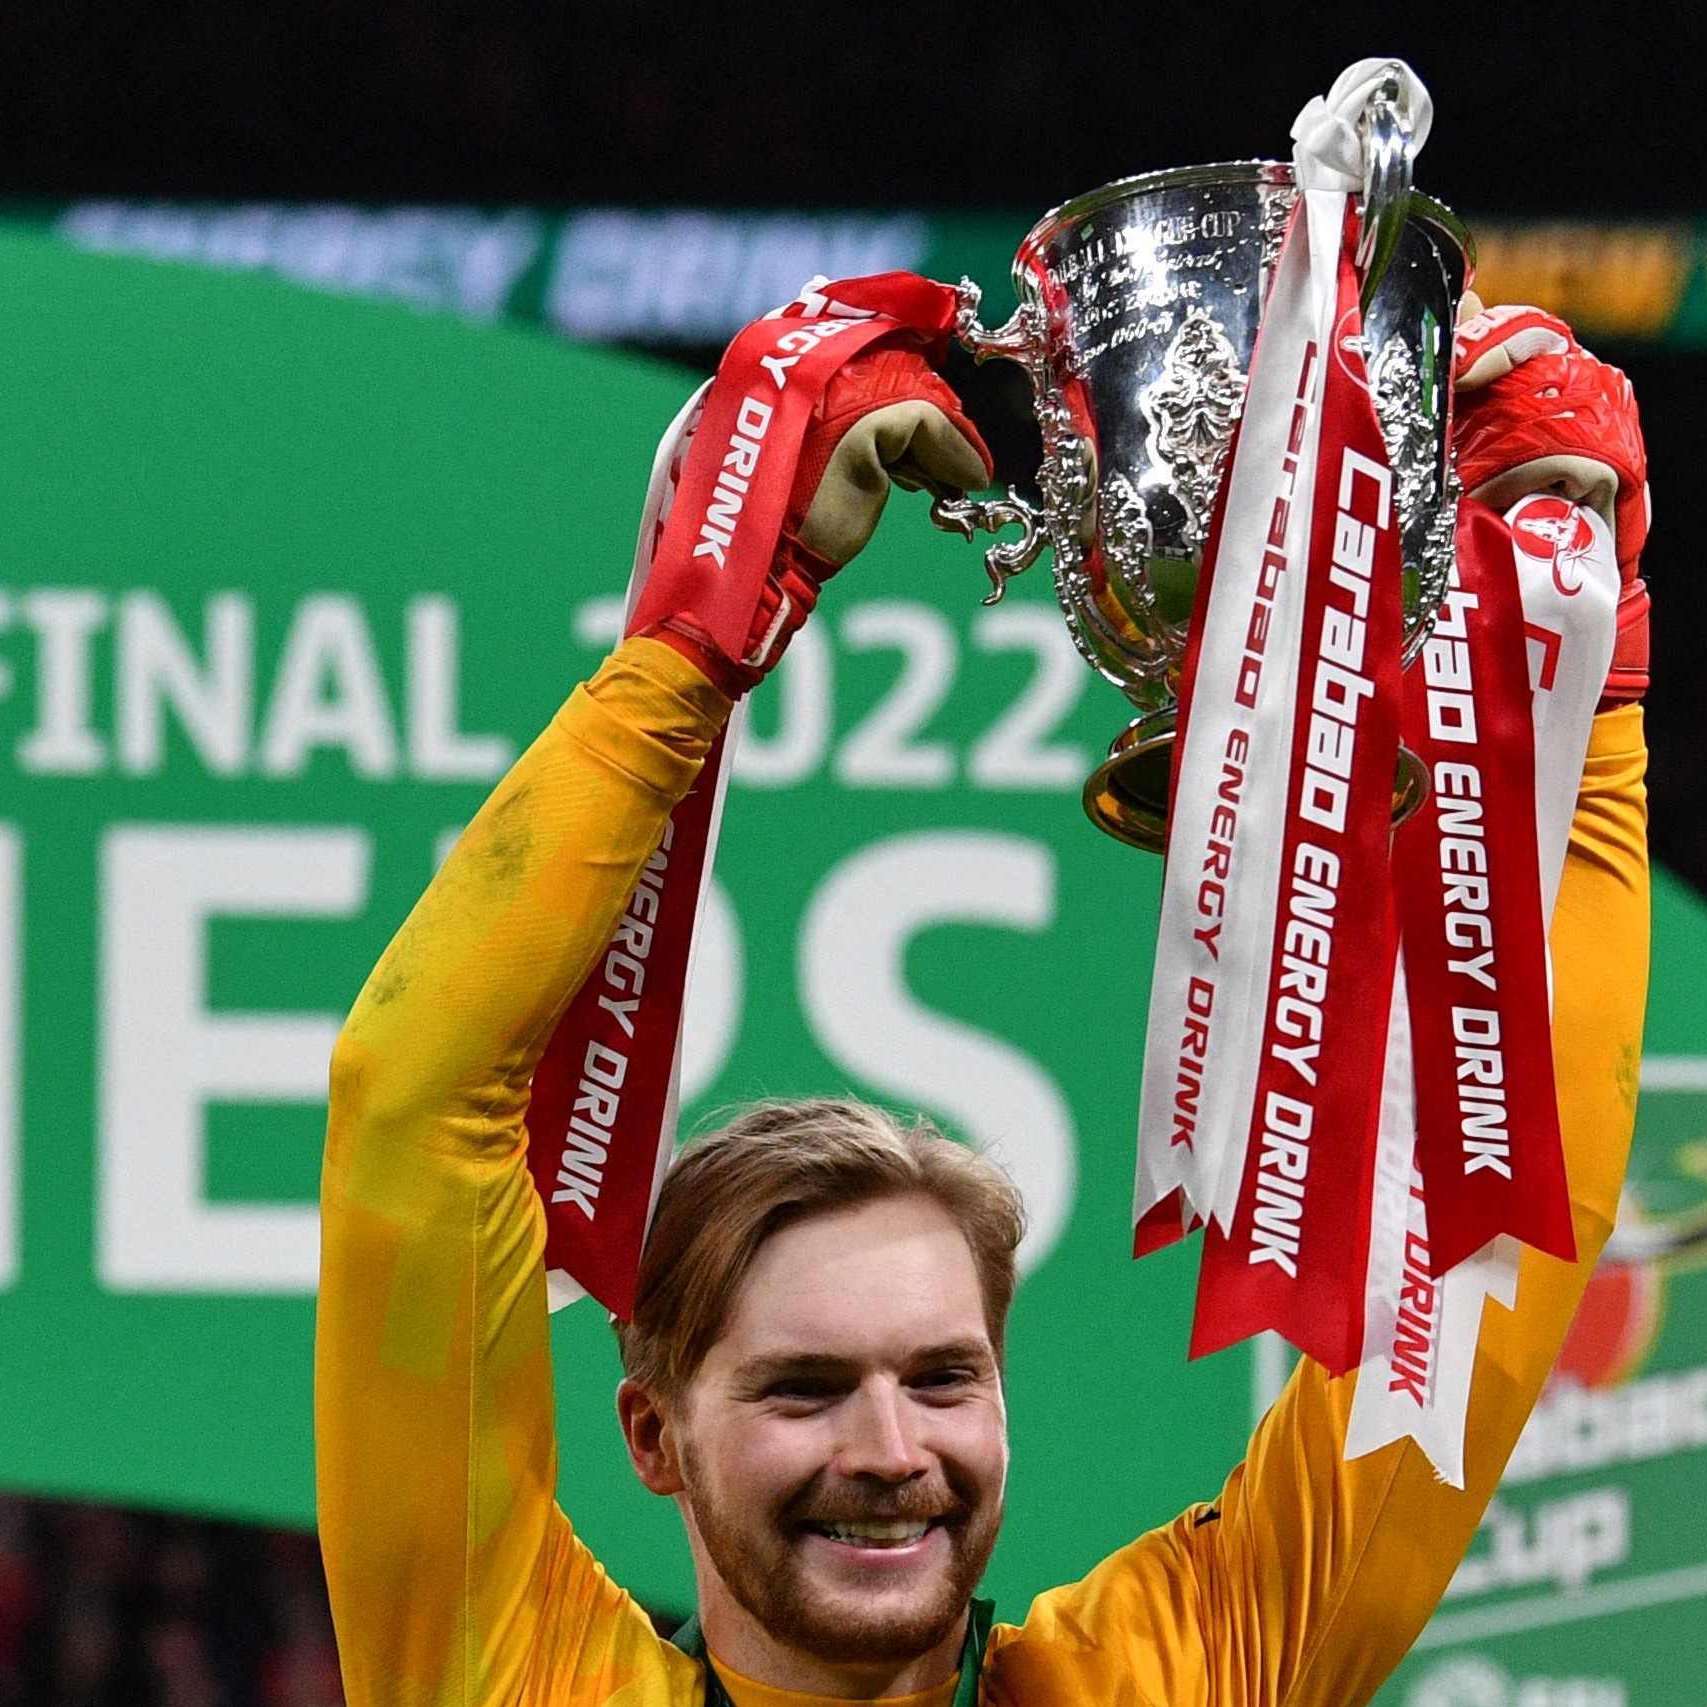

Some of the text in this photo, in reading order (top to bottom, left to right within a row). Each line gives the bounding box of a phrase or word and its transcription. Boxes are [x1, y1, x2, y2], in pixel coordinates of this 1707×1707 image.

[692, 396, 774, 570] DRINK
[569, 596, 1090, 790] 022
[1193, 727, 1250, 962] ENERGY
[1249, 446, 1393, 1280] Carabao ENERGY DRINK
[1434, 761, 1497, 991] ENERGY
[551, 1039, 628, 1221] DRINK
[1170, 975, 1215, 1154] DRINK
[1451, 1006, 1512, 1180] DRINK
[1388, 1230, 1435, 1409] DRINK
